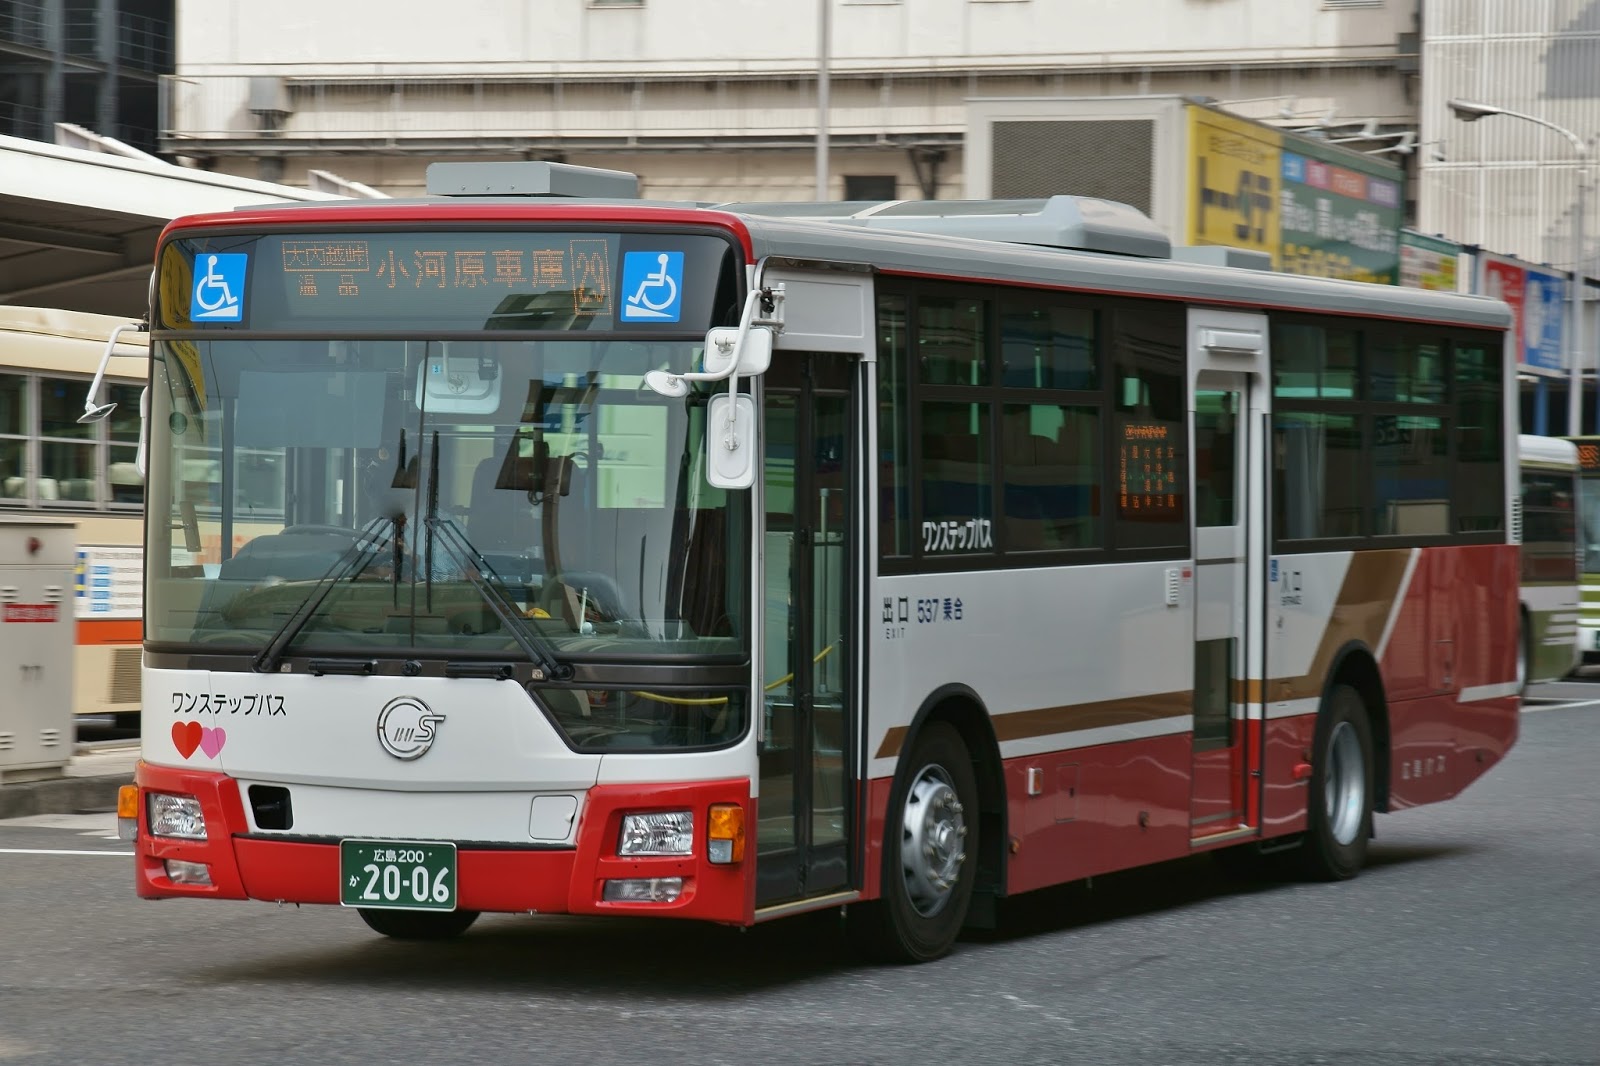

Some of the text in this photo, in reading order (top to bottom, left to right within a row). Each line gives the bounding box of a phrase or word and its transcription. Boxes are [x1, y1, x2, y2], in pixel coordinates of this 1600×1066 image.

[376, 248, 568, 289] 小河原車庫
[922, 518, 993, 552] ワンステップバス
[883, 597, 908, 623] 出口
[917, 598, 939, 624] 537
[886, 627, 905, 640] EXIT
[172, 692, 287, 717] ワンステップバス
[349, 863, 450, 903] か 20-06
